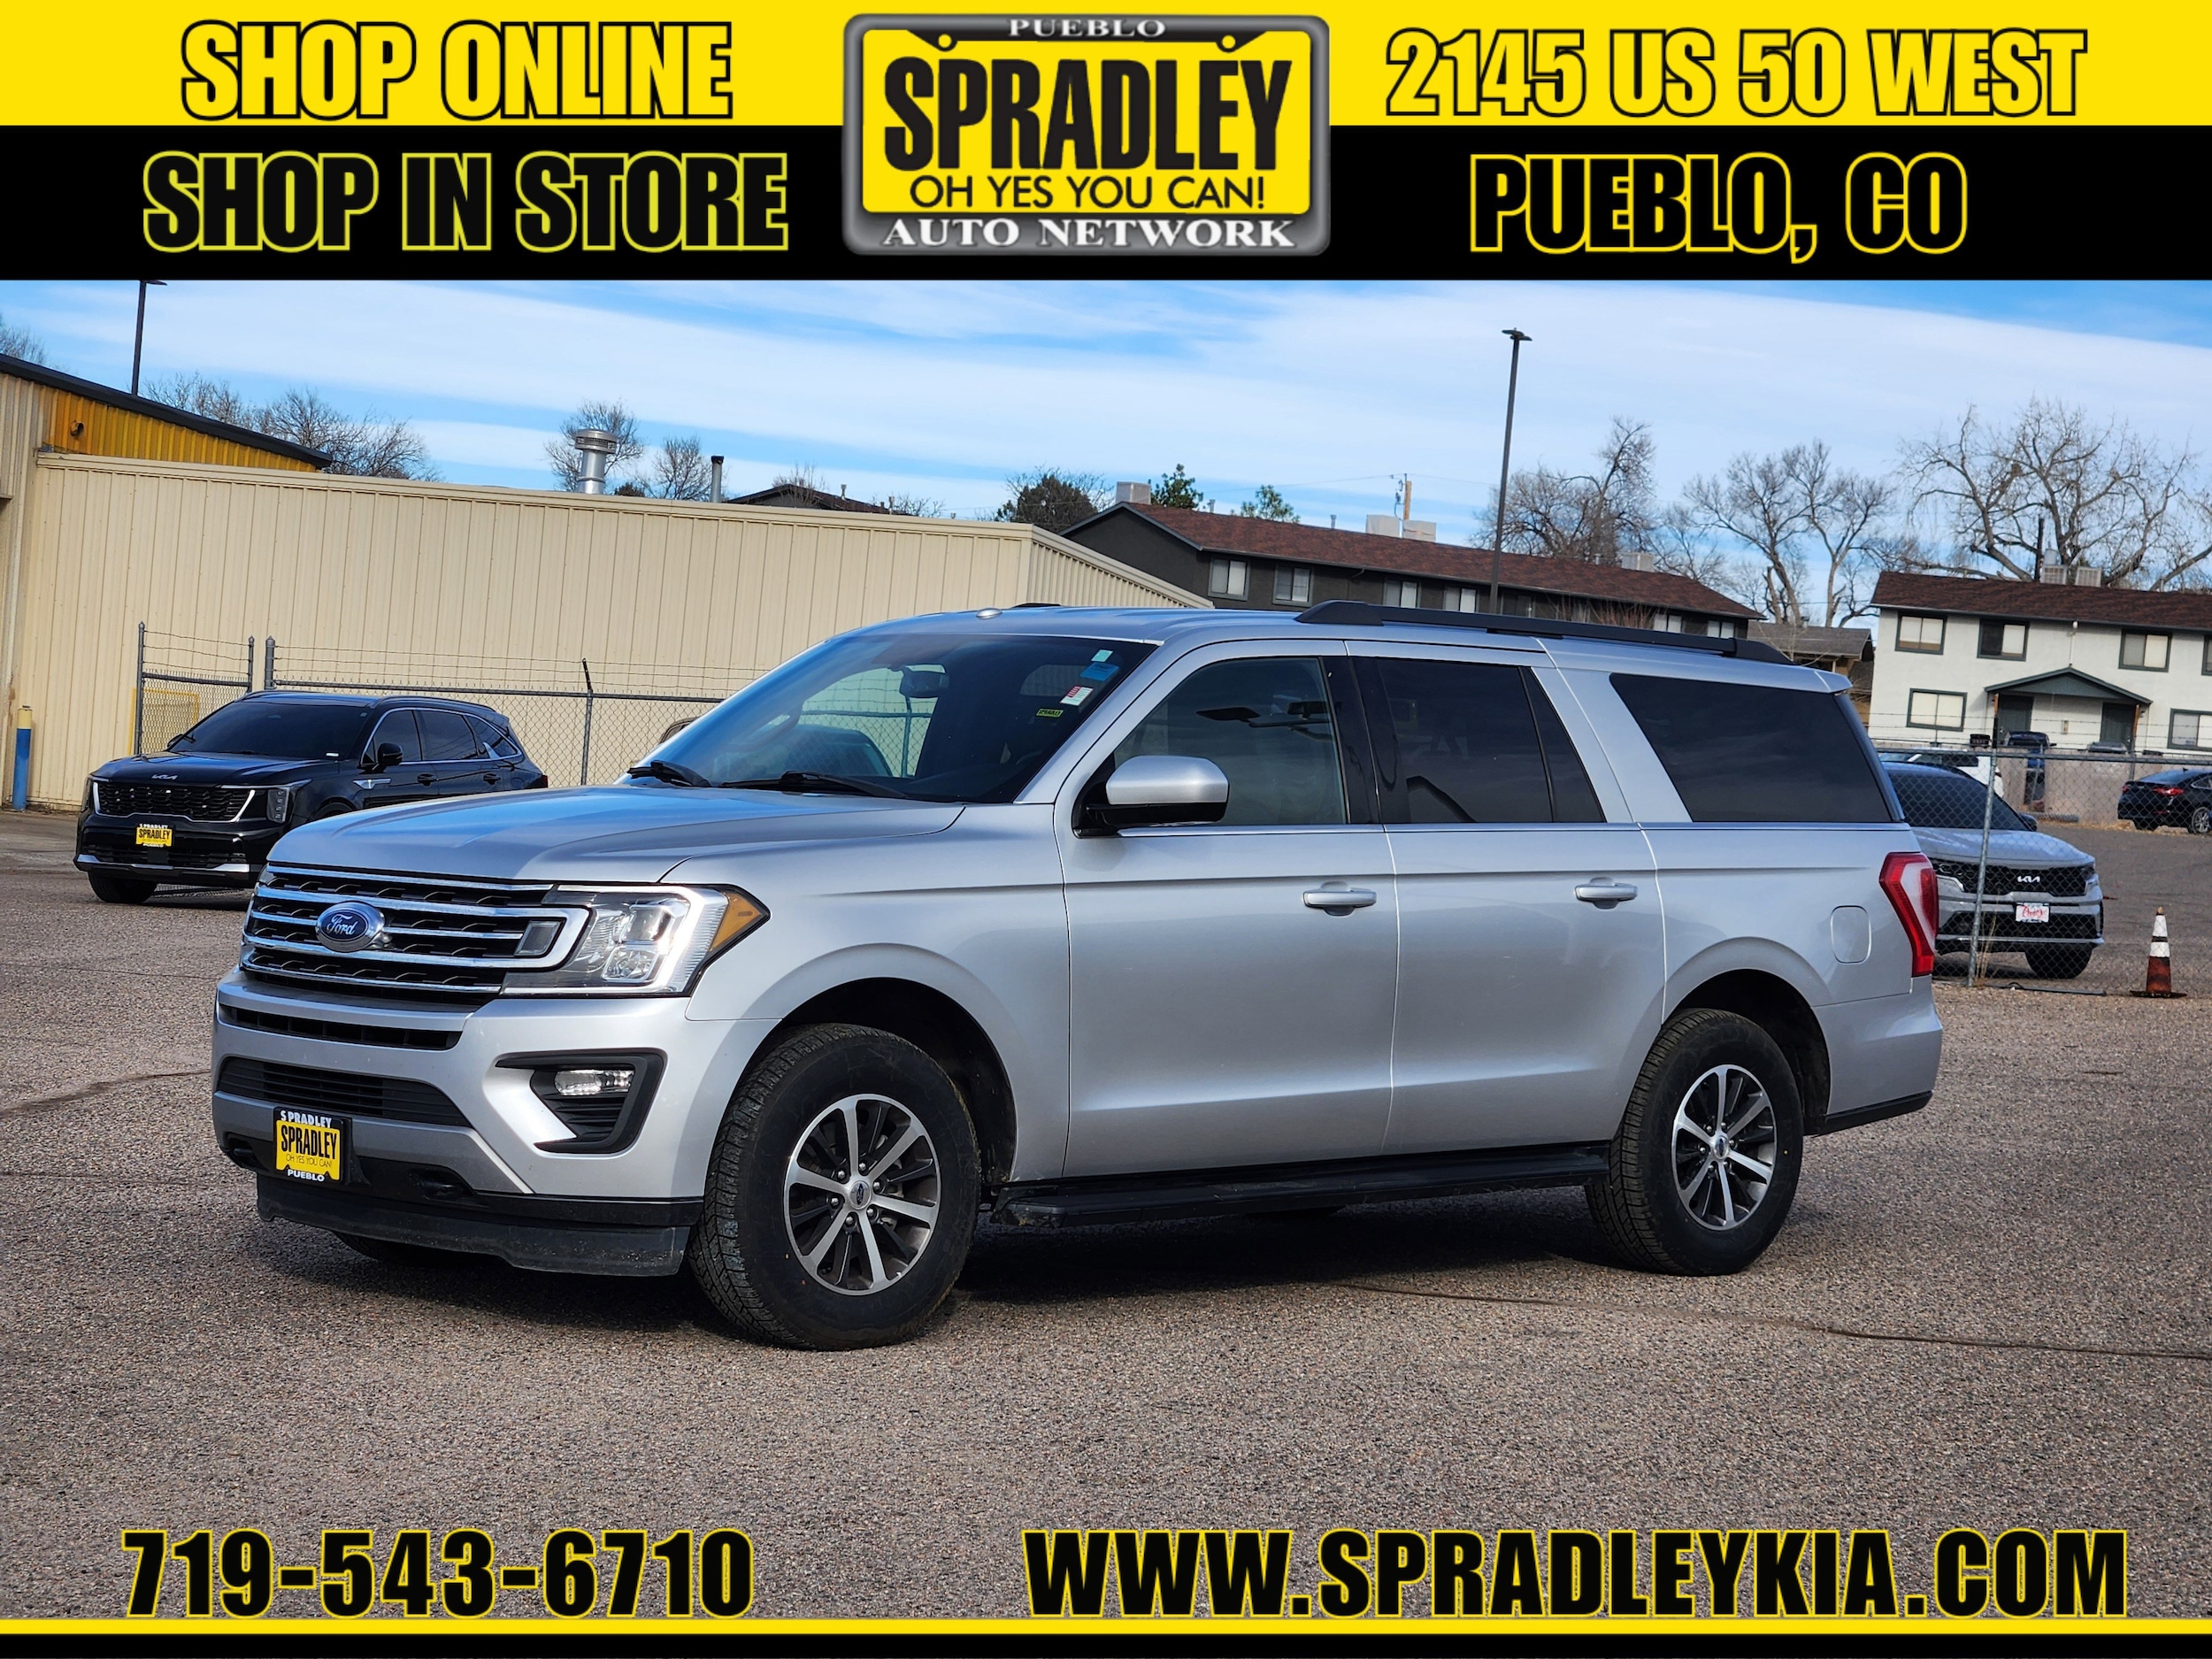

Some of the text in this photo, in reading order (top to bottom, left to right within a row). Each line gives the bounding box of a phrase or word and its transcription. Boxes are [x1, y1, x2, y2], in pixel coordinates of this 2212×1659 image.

[138, 828, 170, 840] SPRADLEY
[326, 914, 358, 935] Ford
[280, 1110, 332, 1128] SPRADLEY
[280, 1125, 337, 1160] SPRADLEY
[296, 1156, 305, 1164] YES
[306, 1156, 318, 1166] YOU
[287, 1169, 325, 1182] PUEBLO
